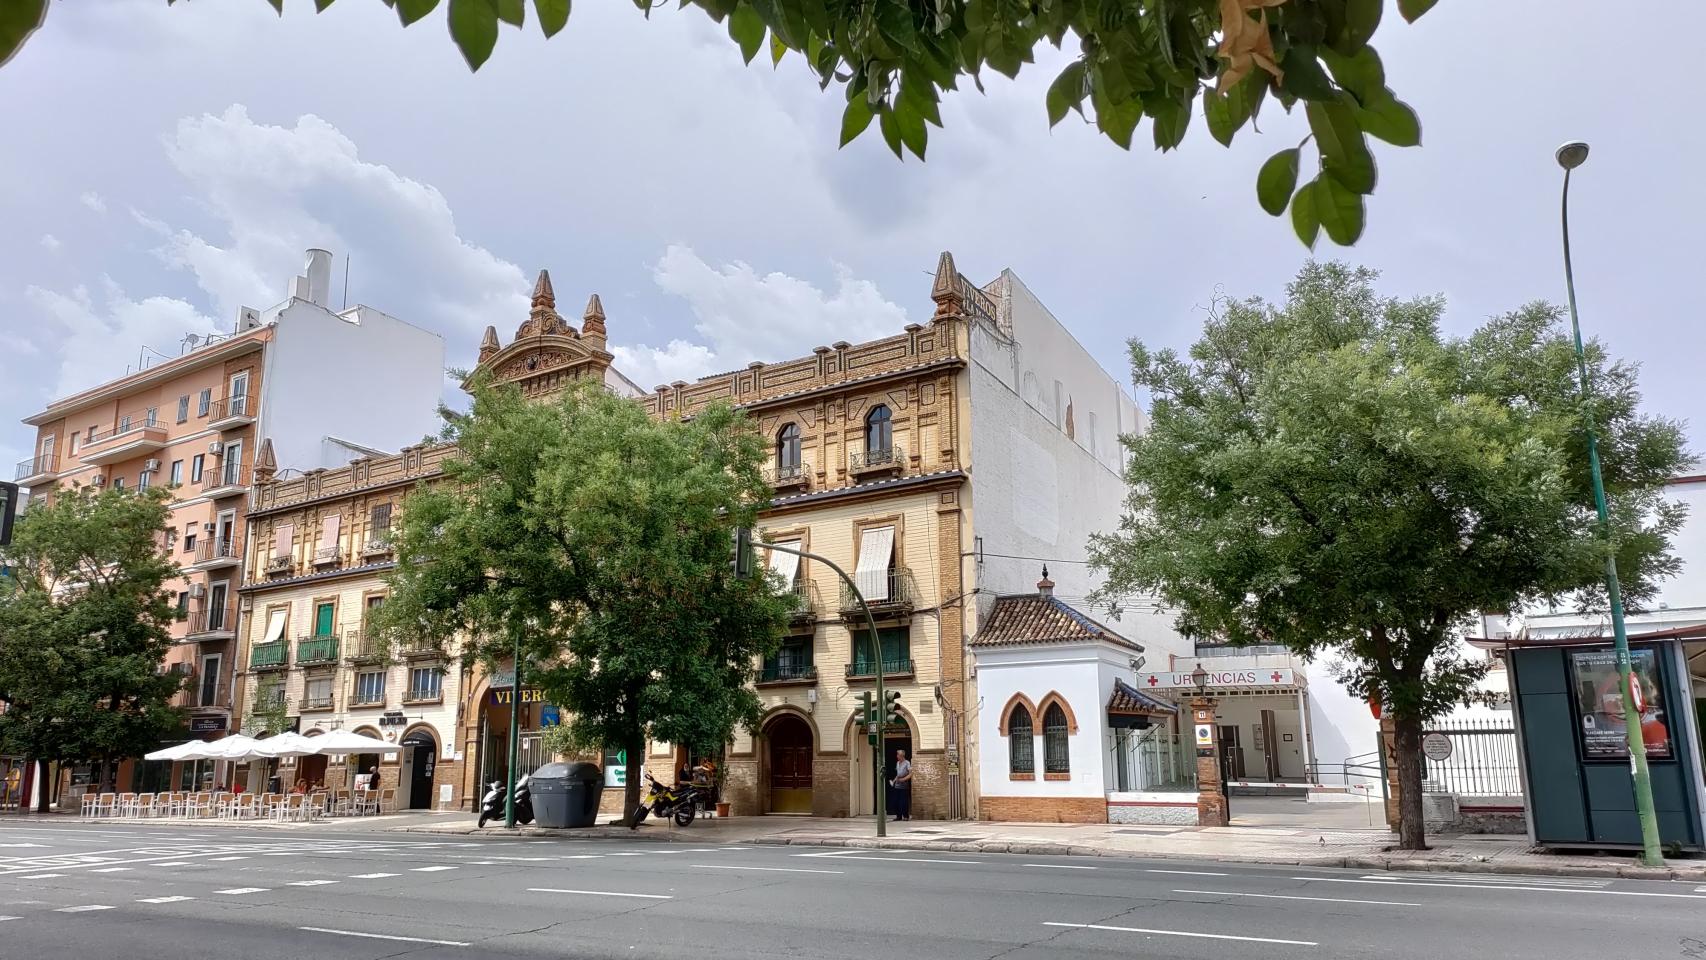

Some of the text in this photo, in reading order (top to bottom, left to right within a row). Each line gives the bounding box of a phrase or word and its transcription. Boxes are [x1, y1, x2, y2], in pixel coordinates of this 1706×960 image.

[960, 276, 995, 321] VIVEROS
[1172, 672, 1256, 685] URENCIAS
[495, 689, 549, 704] VIER
